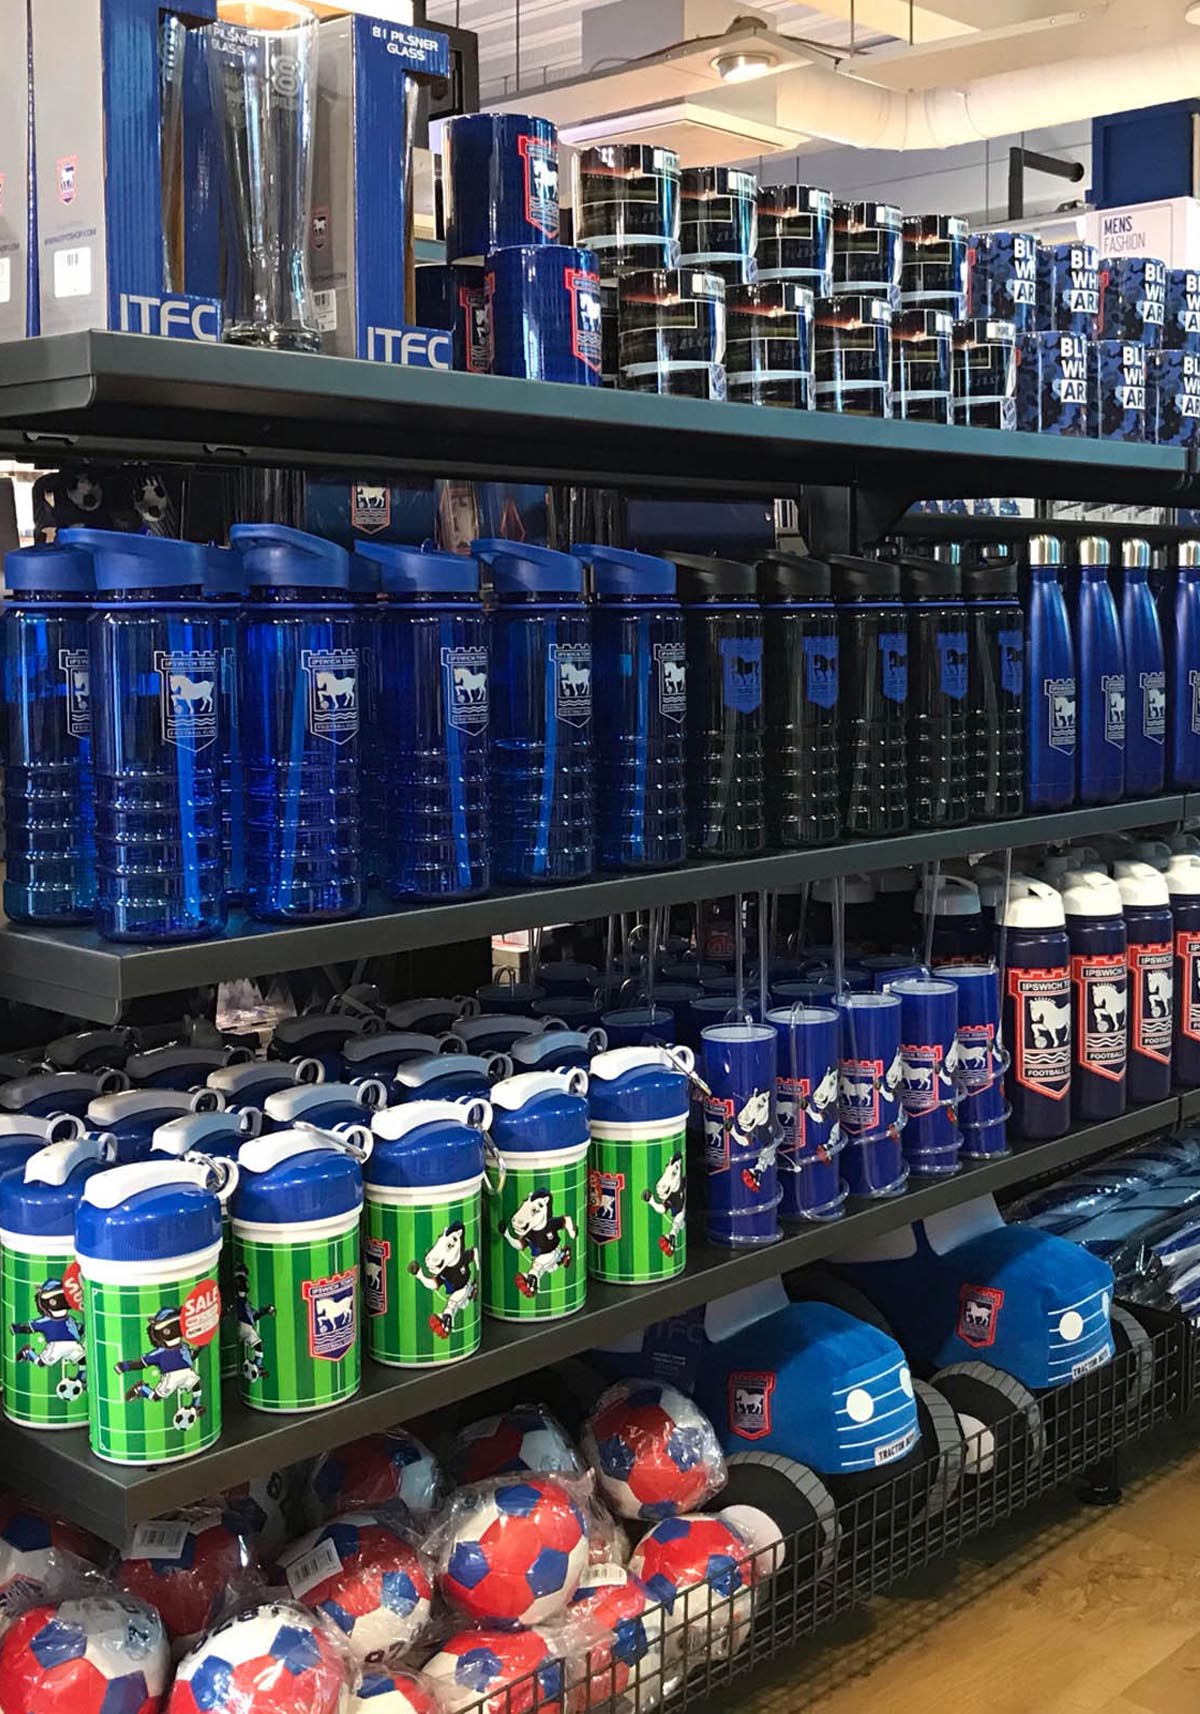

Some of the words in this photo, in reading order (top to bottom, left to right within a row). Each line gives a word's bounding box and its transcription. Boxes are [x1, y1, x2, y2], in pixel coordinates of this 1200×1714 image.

[386, 42, 426, 61] GLASS
[390, 30, 438, 52] PILSNER
[1104, 216, 1132, 234] MENS
[1103, 232, 1146, 253] FASHION
[119, 293, 217, 342] ITFC
[367, 326, 449, 370] ITFC
[1022, 981, 1063, 991] IPSWICH
[1027, 1068, 1064, 1077] FOOTBALL
[184, 1285, 219, 1317] SALE
[878, 1439, 905, 1462] TRACTOR
